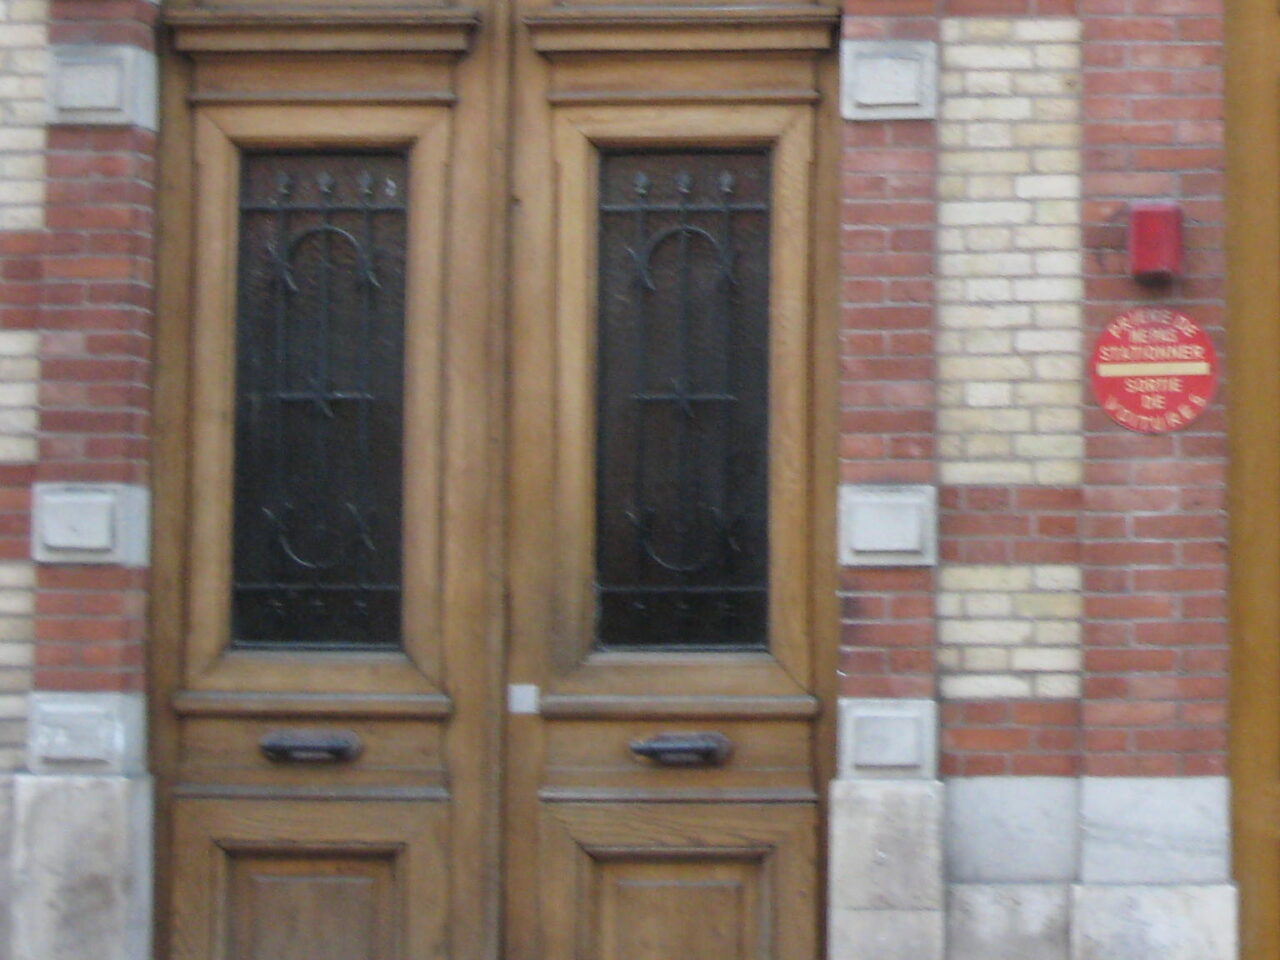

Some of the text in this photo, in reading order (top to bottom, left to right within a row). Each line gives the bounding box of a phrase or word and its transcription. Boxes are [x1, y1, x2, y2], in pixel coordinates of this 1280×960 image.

[1174, 315, 1200, 338] DE
[1130, 329, 1149, 343] NE
[1099, 344, 1205, 361] STATIONNER
[1125, 377, 1184, 393] SORTIE
[1141, 395, 1166, 410] DE
[1105, 394, 1208, 431] VOITURES
